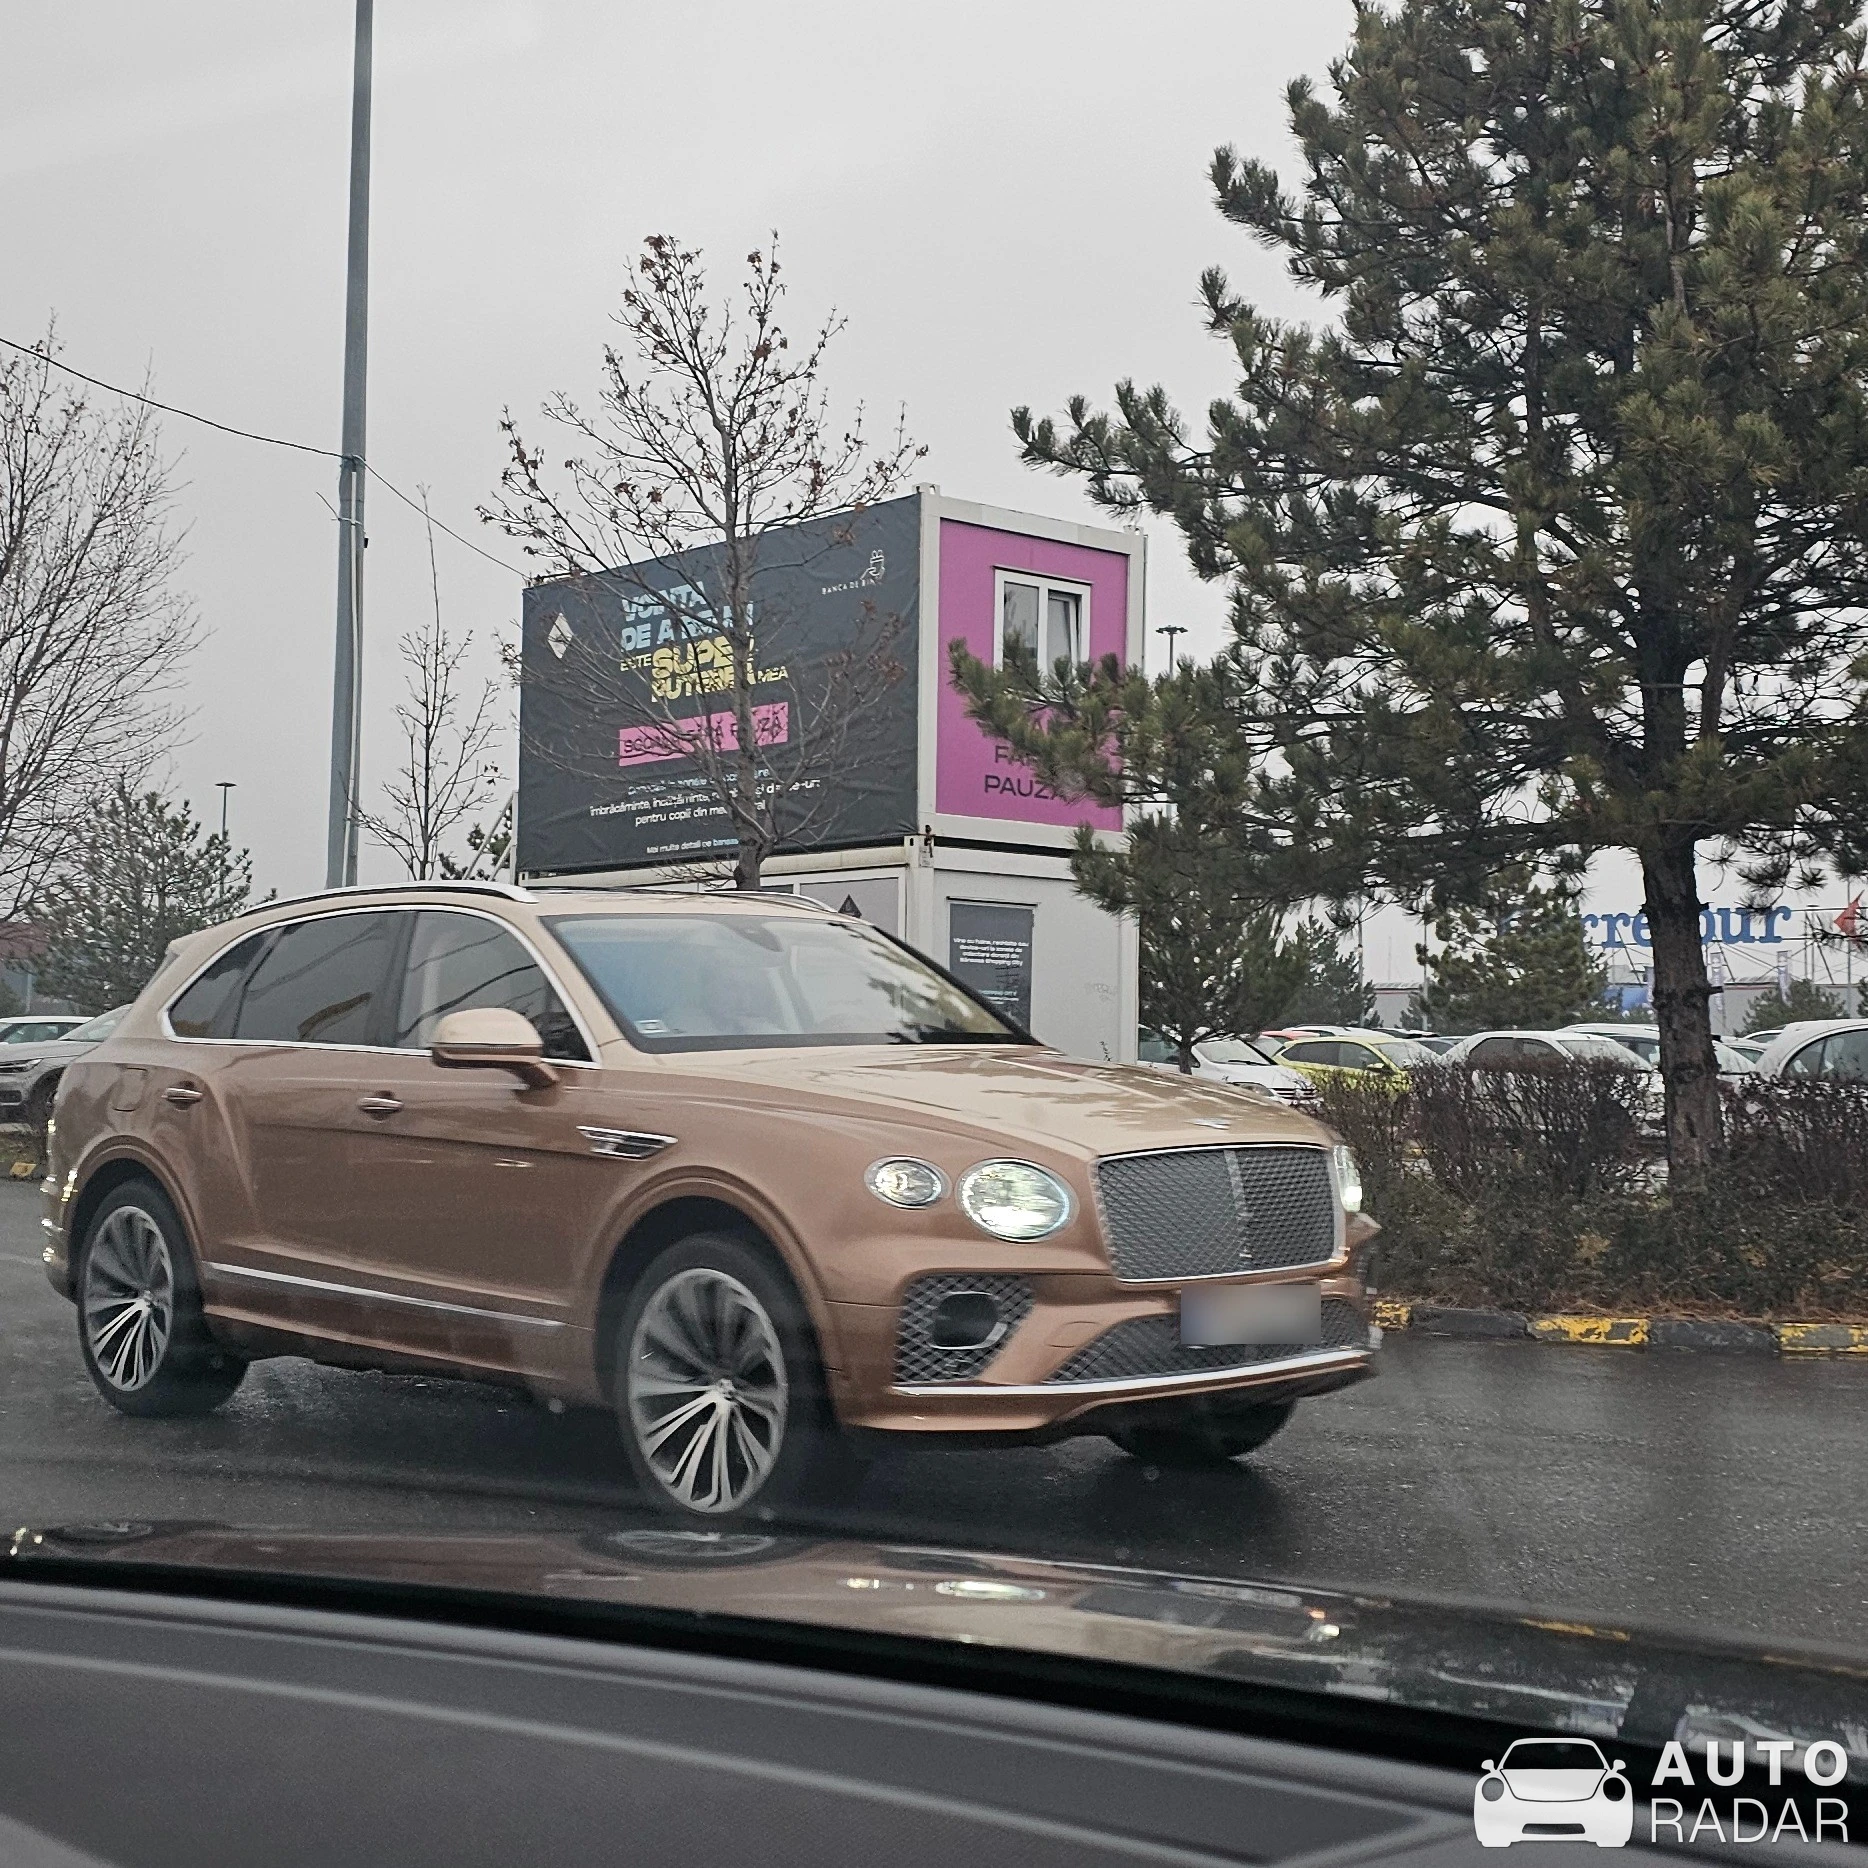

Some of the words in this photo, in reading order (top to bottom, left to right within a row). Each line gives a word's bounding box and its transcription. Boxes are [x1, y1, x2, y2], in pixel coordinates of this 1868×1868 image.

[822, 583, 848, 595] BANCA
[621, 624, 652, 651] DE
[657, 619, 675, 645] A
[620, 653, 652, 672] ESTE
[757, 666, 790, 685] MEA
[984, 774, 1065, 801] PAUZ
[635, 813, 667, 828] pentru
[693, 806, 708, 818] din
[1578, 905, 1792, 949] rreour
